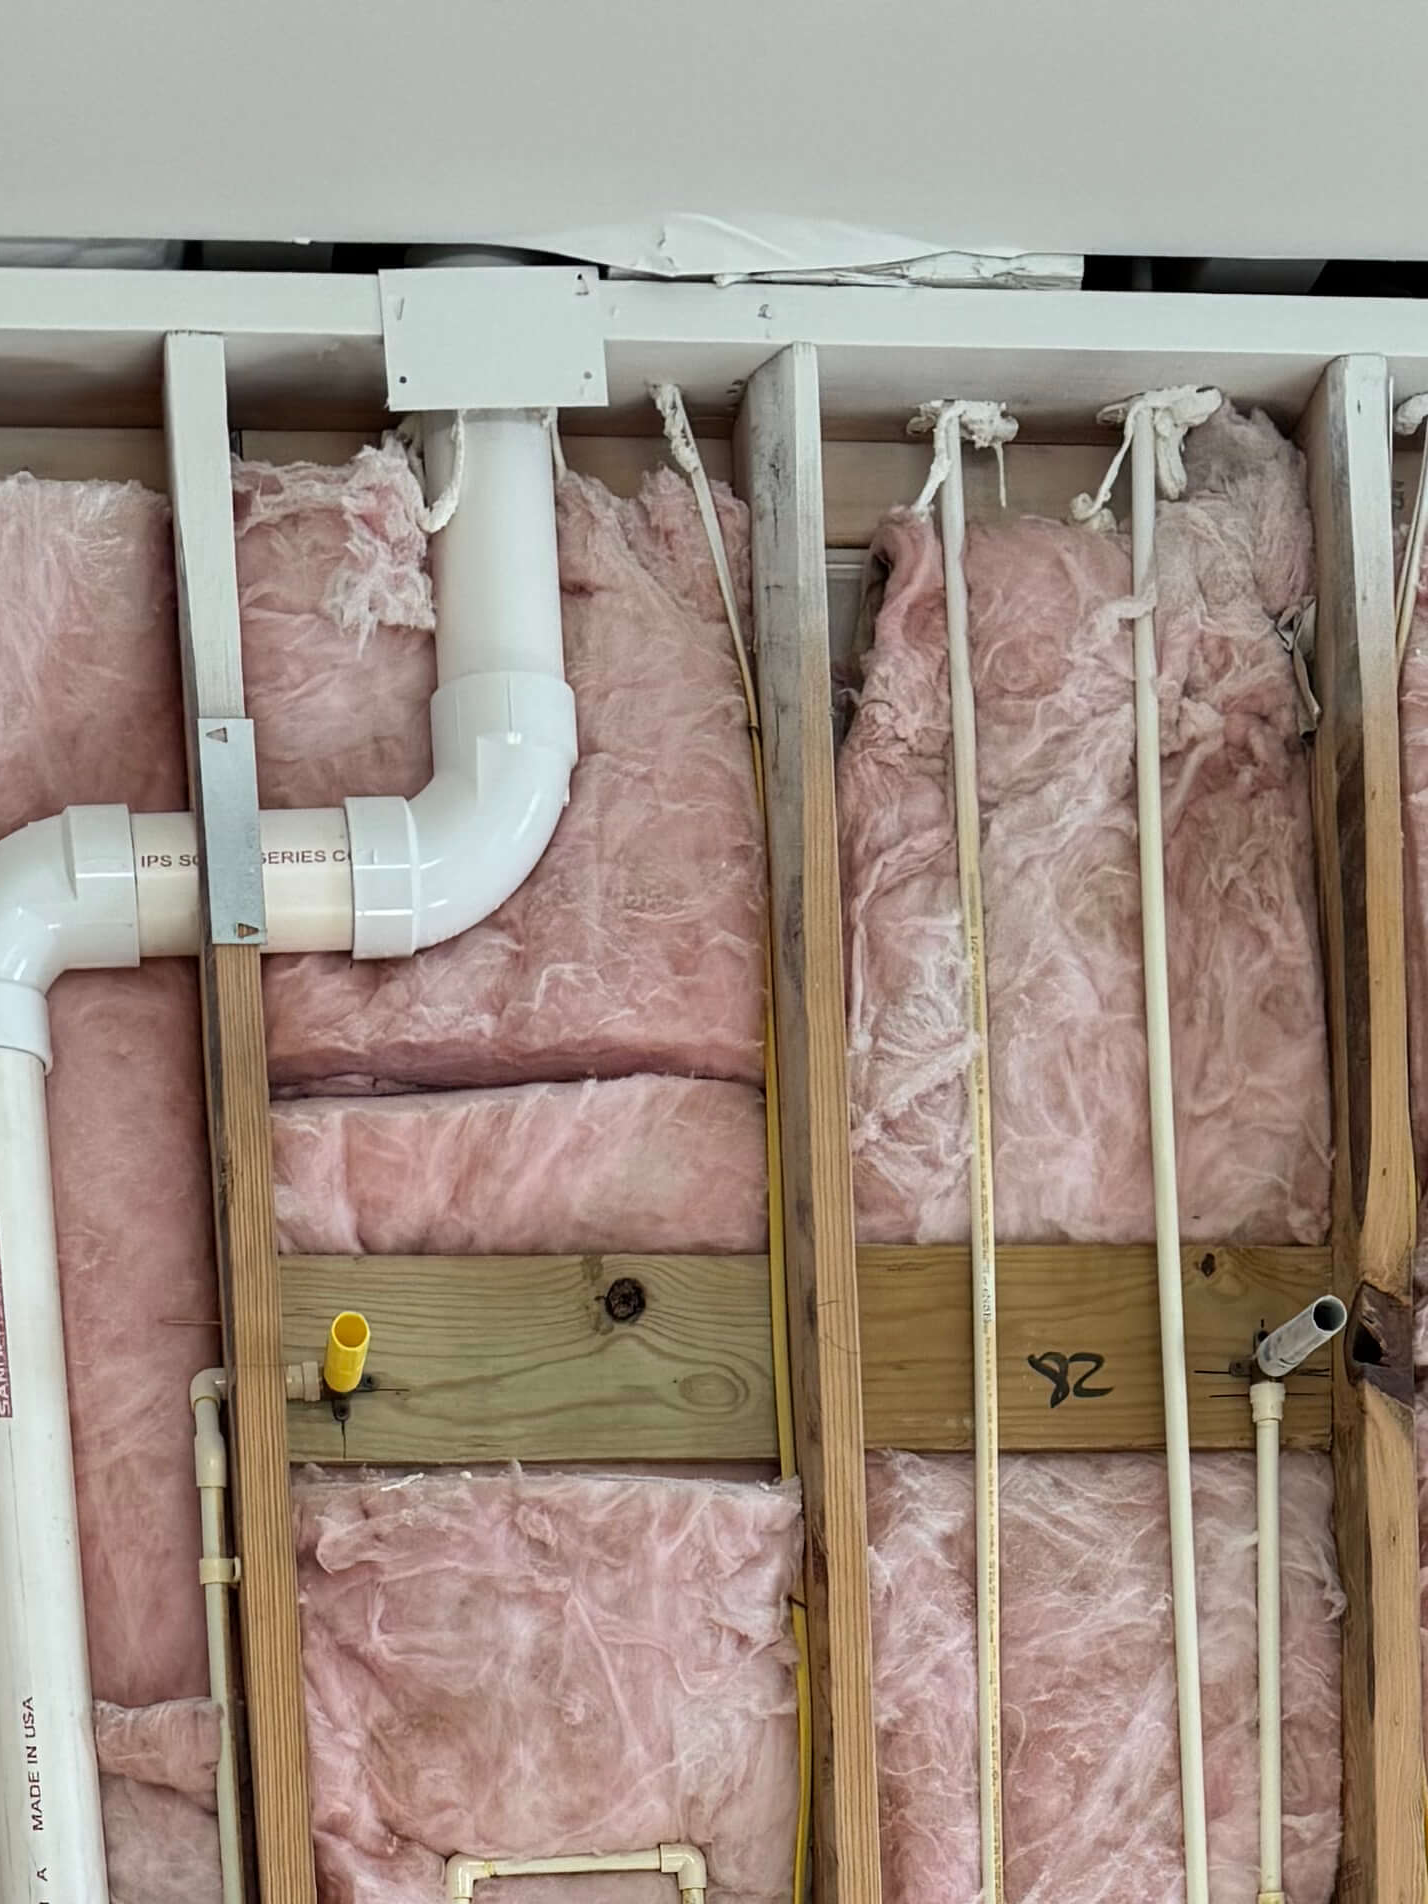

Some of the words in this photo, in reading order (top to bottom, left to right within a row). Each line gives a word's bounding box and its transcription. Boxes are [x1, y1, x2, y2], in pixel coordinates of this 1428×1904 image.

[141, 854, 172, 868] IPS
[22, 1696, 36, 1738] USA
[25, 1745, 39, 1764] IN
[27, 1771, 44, 1831] MADE
[36, 1867, 48, 1882] A
